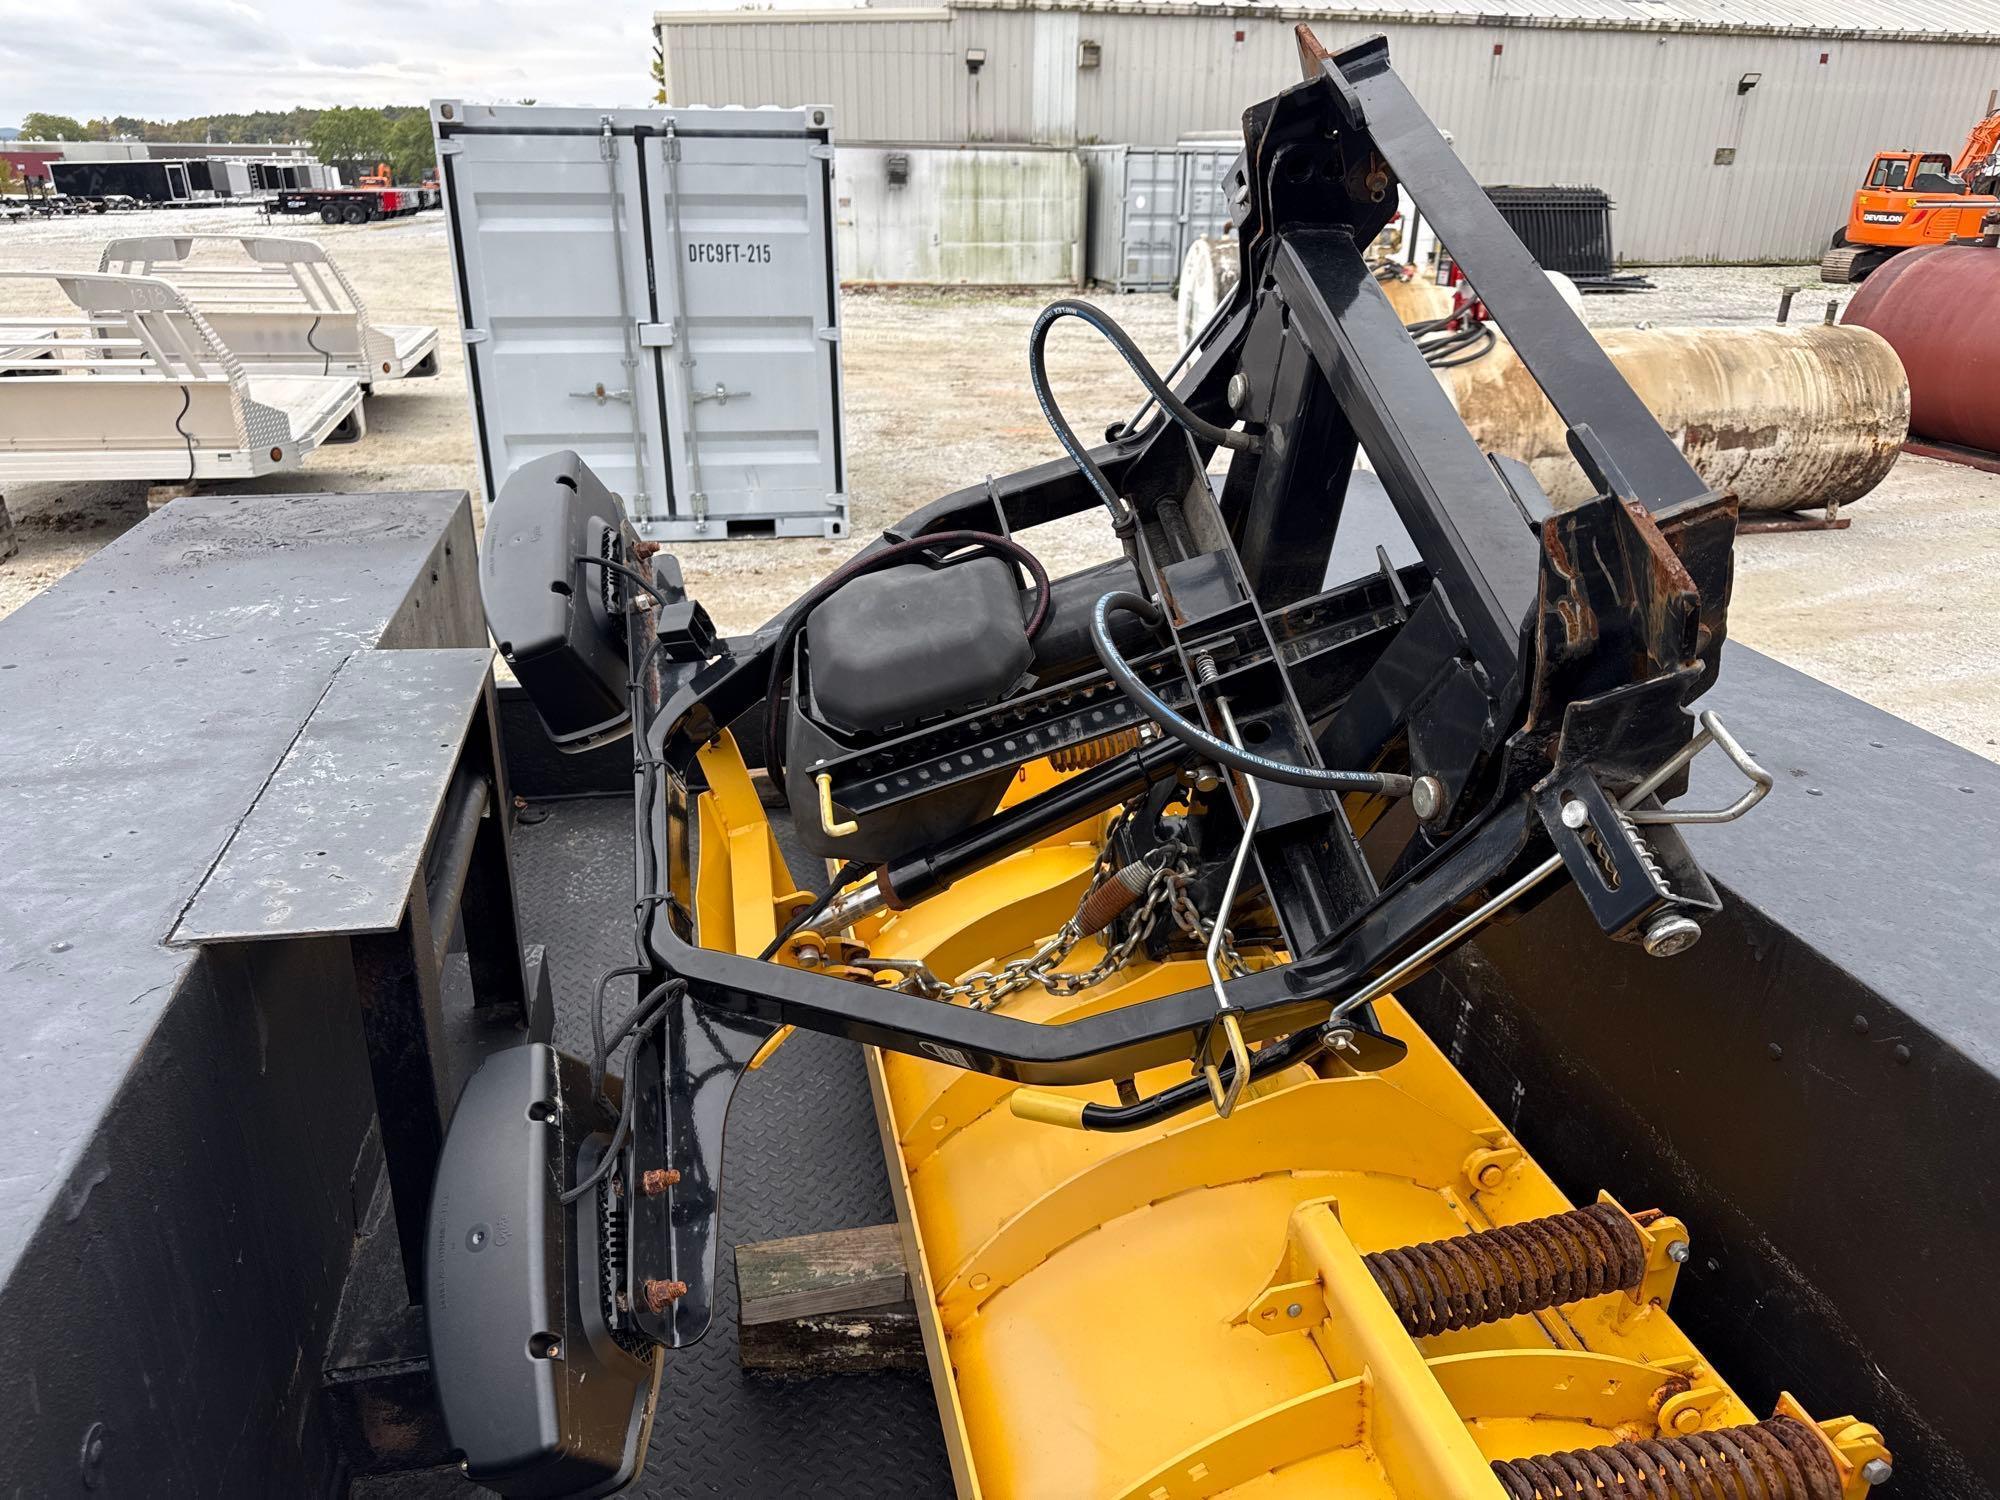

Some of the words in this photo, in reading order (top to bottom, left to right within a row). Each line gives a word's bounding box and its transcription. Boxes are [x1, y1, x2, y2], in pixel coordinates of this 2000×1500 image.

[1863, 213, 1903, 222] DEVELON
[688, 243, 771, 264] DFC9FT-215
[130, 287, 167, 306] 1318
[1331, 771, 1346, 780] SAE
[1346, 772, 1359, 781] 100
